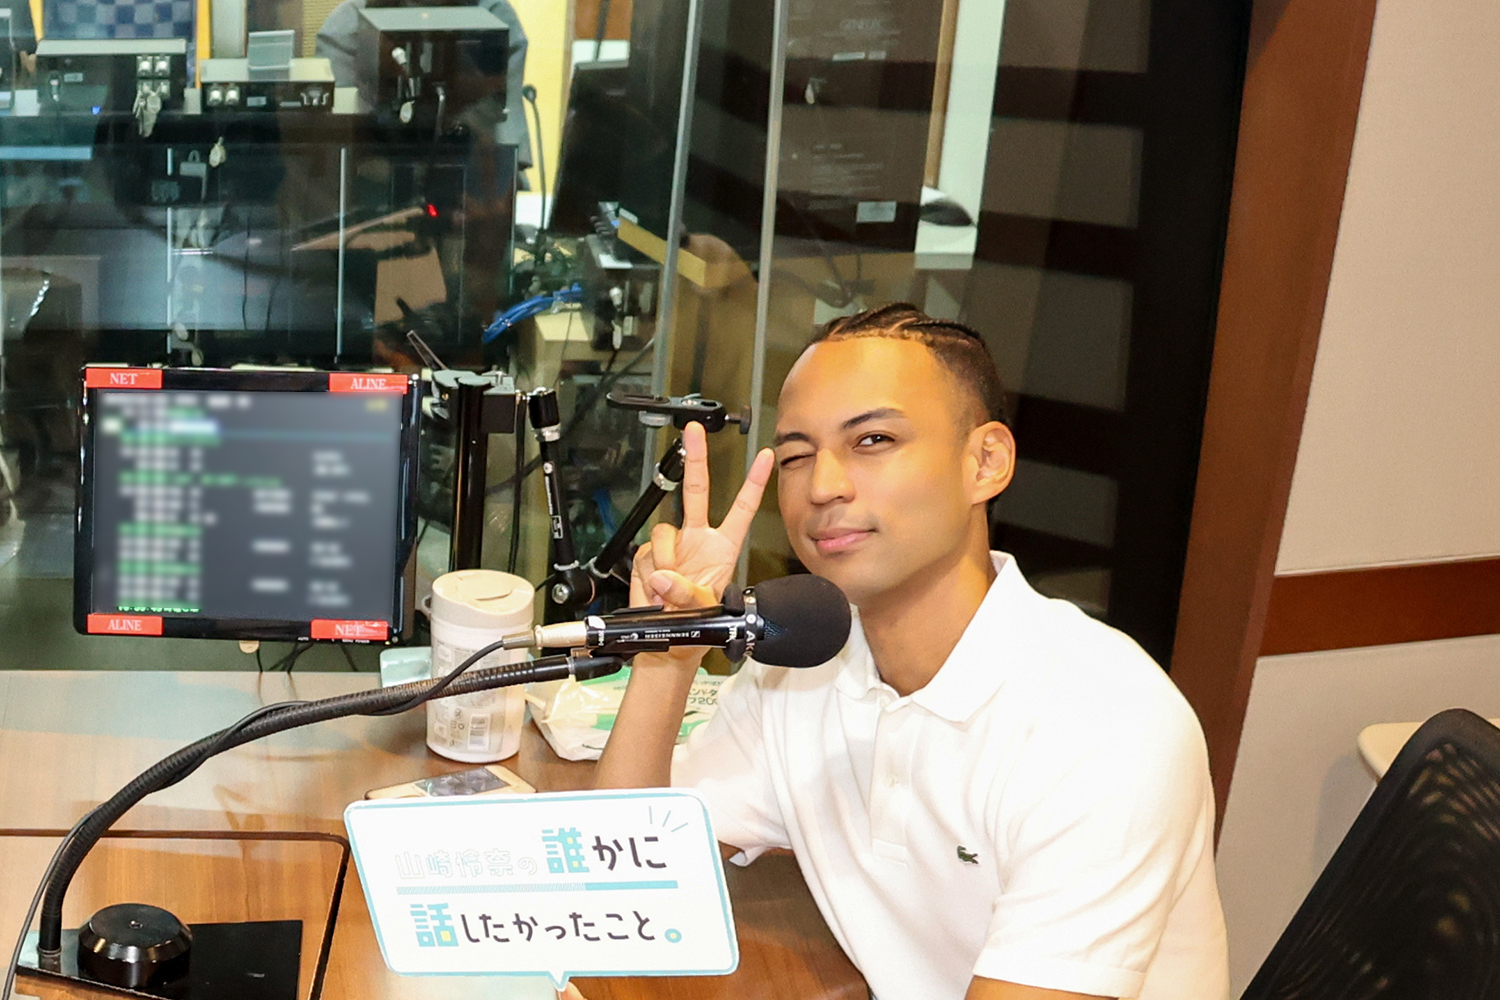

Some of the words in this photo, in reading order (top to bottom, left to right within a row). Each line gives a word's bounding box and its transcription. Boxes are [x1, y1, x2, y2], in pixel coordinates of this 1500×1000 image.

[109, 373, 138, 385] NET
[350, 377, 387, 391] ALINE
[107, 619, 143, 631] ALINE
[334, 623, 363, 636] NET
[410, 903, 683, 948] 話したかったこと。
